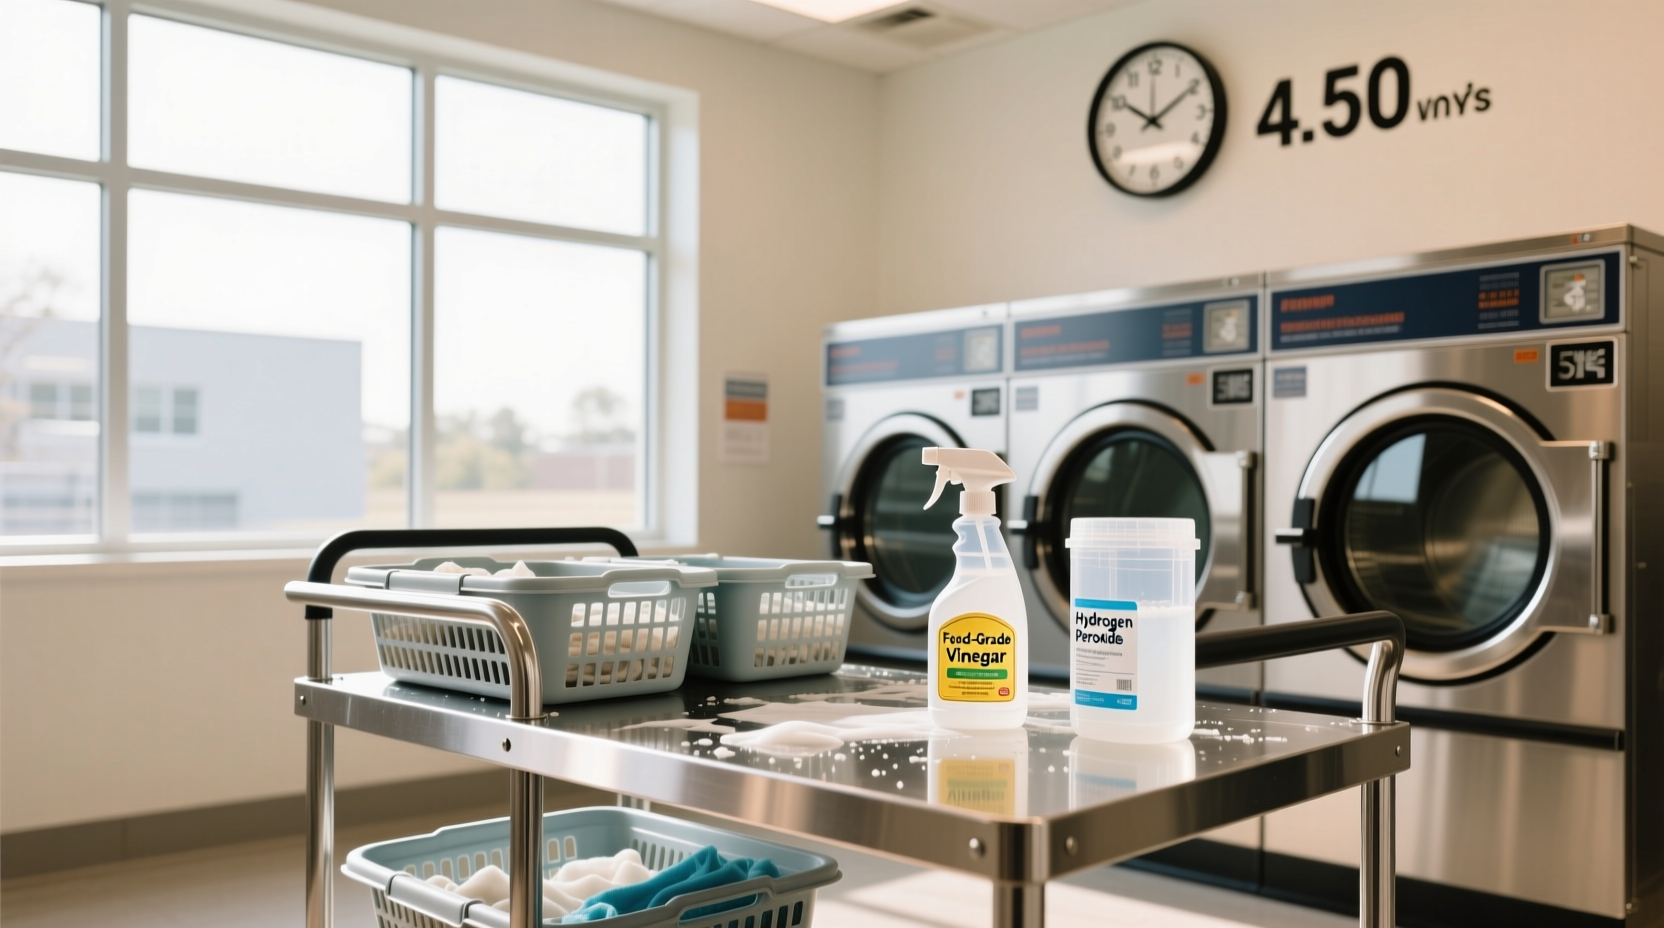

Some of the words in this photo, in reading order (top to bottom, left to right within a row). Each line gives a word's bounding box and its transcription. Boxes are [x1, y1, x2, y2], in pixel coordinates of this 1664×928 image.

[1148, 59, 1163, 76] 12
[1174, 63, 1181, 78] 1
[1127, 71, 1140, 88] 11
[1188, 78, 1200, 96] 2
[1112, 94, 1127, 112] 10
[1256, 56, 1411, 146] 4.50
[1195, 104, 1206, 121] 3
[1190, 131, 1200, 145] 4
[1149, 164, 1160, 181] 6
[1075, 611, 1134, 633] Hydrogen
[946, 647, 1007, 667] Vinegar
